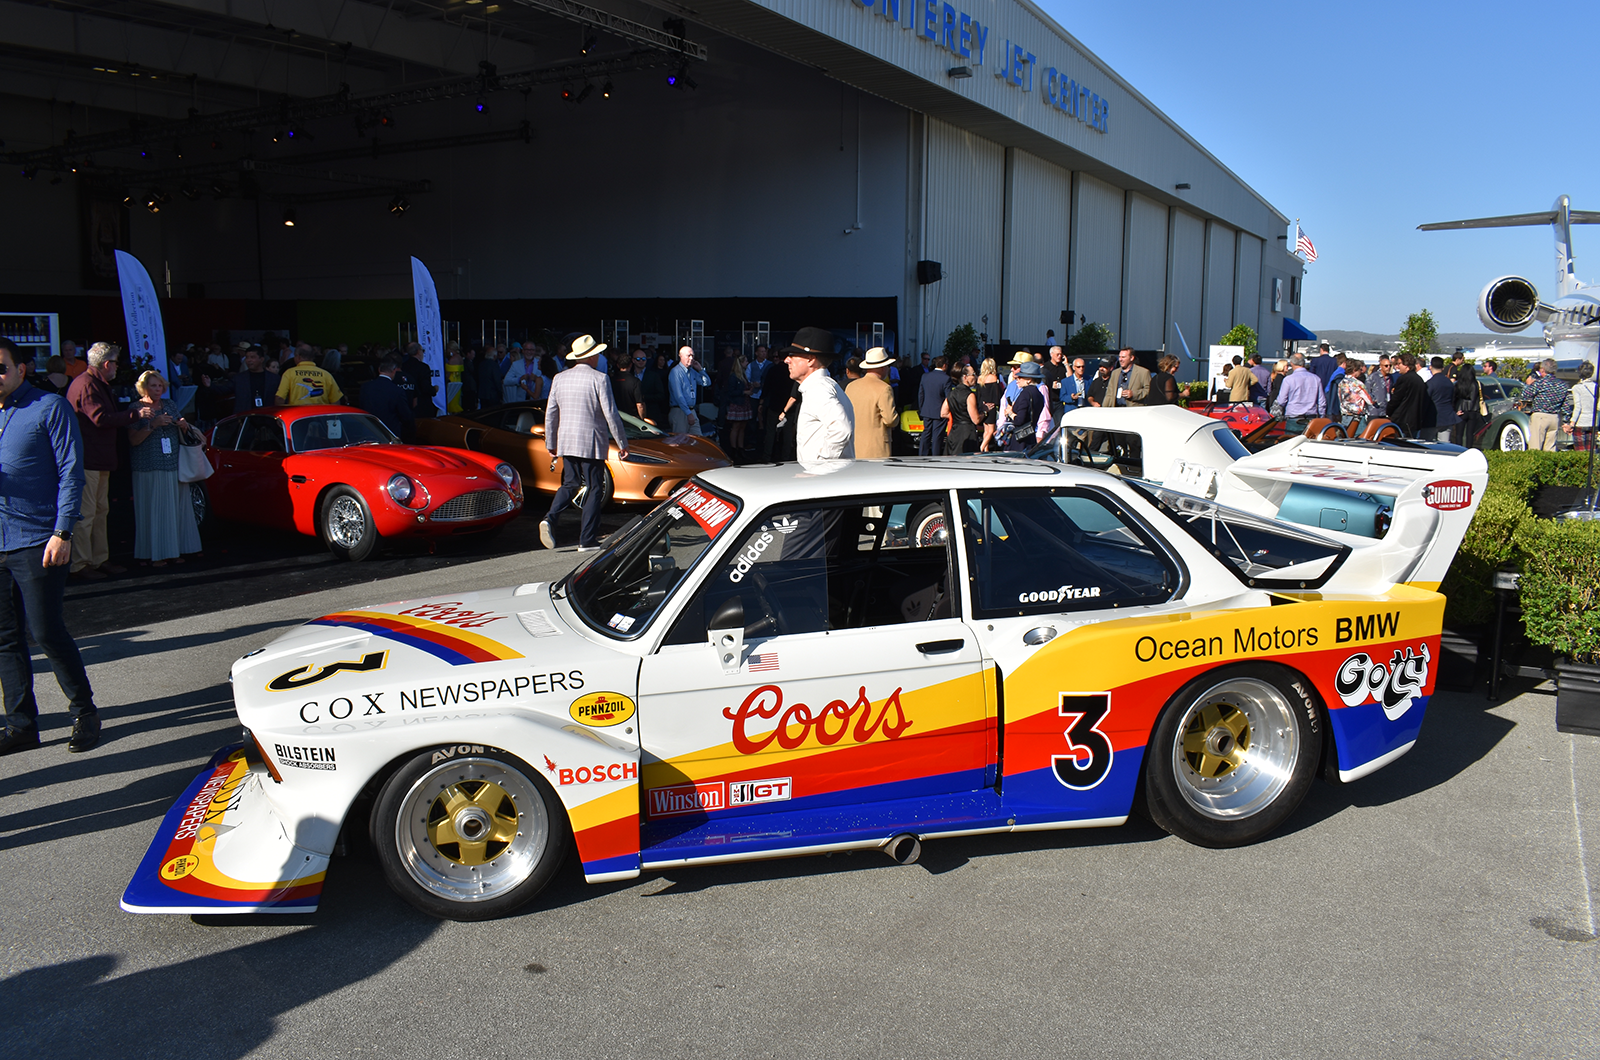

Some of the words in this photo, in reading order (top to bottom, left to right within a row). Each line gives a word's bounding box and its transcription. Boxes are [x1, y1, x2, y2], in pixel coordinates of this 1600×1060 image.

[849, 0, 988, 66] TEREY
[996, 39, 1036, 92] JET
[1042, 66, 1109, 134] CENTER
[130, 292, 138, 326] Collection
[1427, 485, 1470, 504] GUMOUT
[695, 497, 734, 528] BMW
[729, 530, 774, 583] adidas
[1019, 585, 1101, 603] GOODYEAR
[398, 601, 508, 628] Coors
[1135, 636, 1223, 663] Ocean
[1233, 625, 1319, 654] Motors
[1335, 611, 1400, 644] BMW
[265, 650, 390, 692] 3
[1335, 643, 1430, 721] Gotti
[299, 692, 386, 724] COX
[400, 670, 585, 711] NEWSPAPERS
[578, 701, 626, 717] PENNZOIL
[1291, 682, 1316, 720] AVON
[722, 684, 914, 755] Coors
[274, 743, 336, 762] BILSTEIN
[431, 745, 485, 766] AVON
[1051, 691, 1114, 791] 3
[559, 762, 637, 785] BOSCH
[755, 783, 788, 798] GT
[174, 773, 229, 840] NEWSPAPERS
[653, 789, 720, 812] Winston
